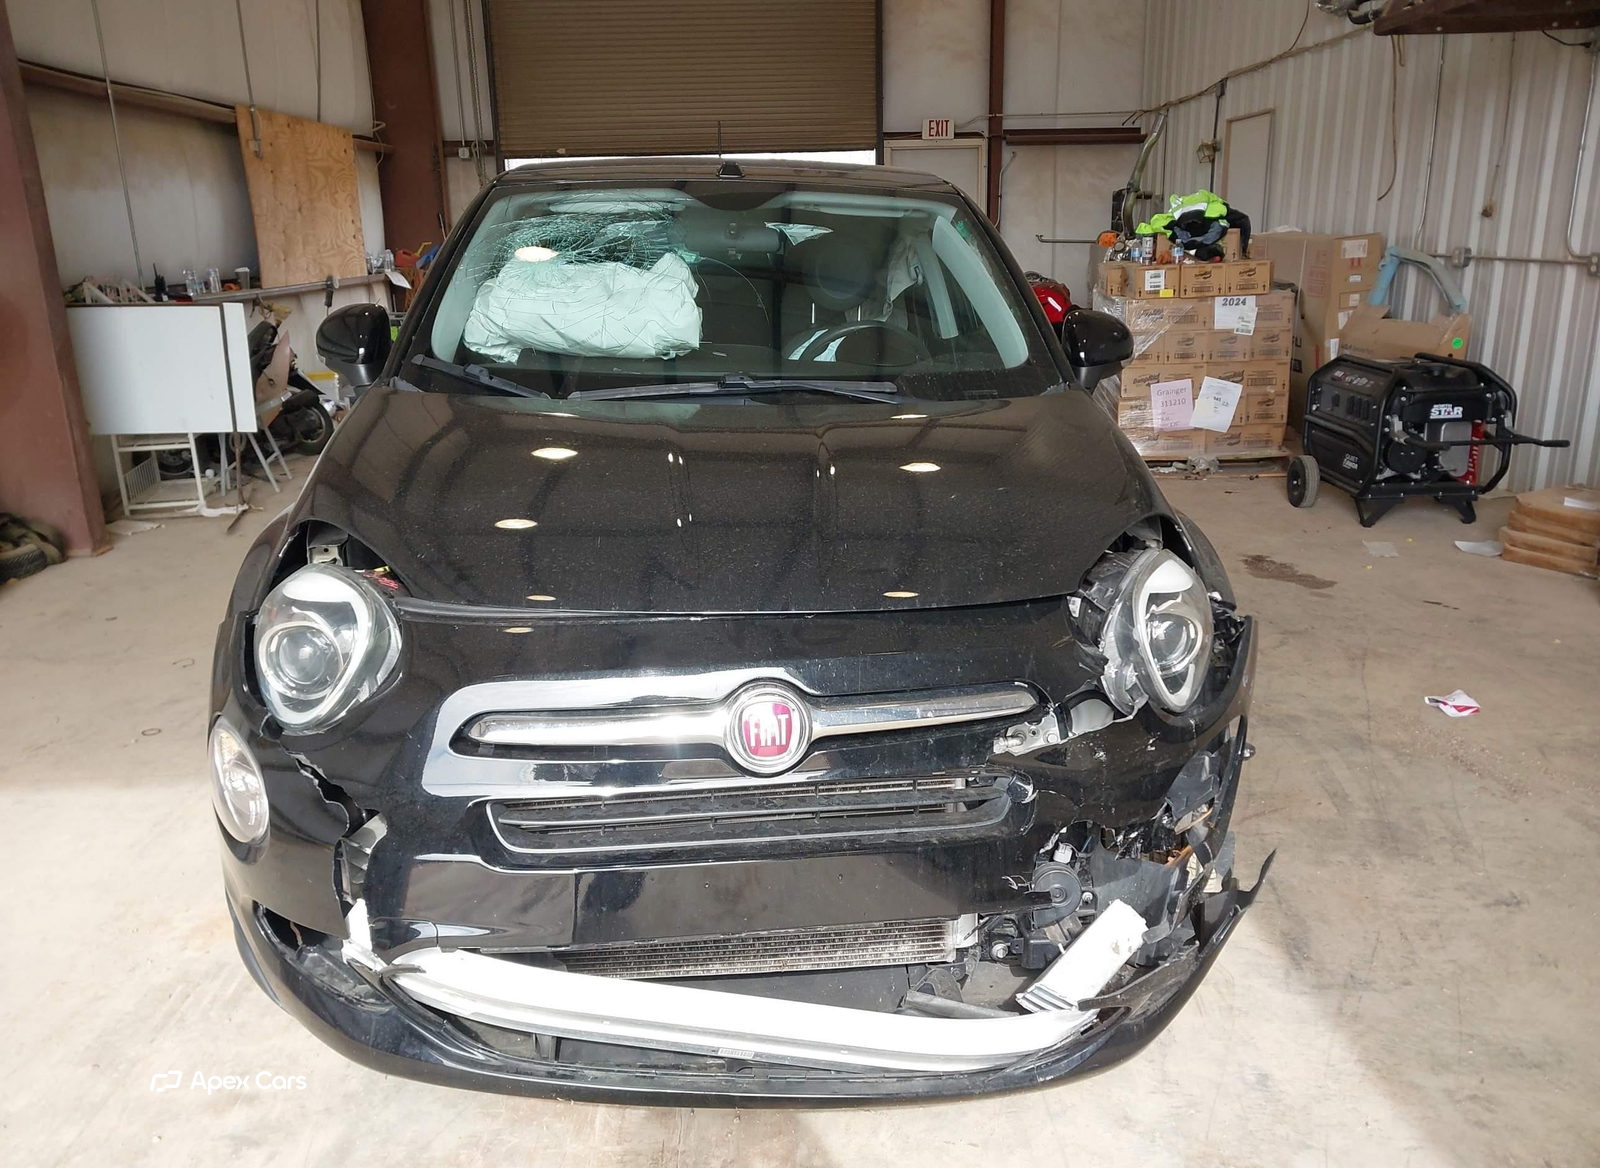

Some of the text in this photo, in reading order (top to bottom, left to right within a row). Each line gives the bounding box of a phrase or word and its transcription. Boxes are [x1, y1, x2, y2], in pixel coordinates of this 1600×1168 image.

[928, 119, 950, 137] EXIT
[1221, 297, 1247, 306] 2024
[1156, 387, 1187, 397] Grainger
[1160, 397, 1187, 408] 311210
[1430, 406, 1463, 416] STAR
